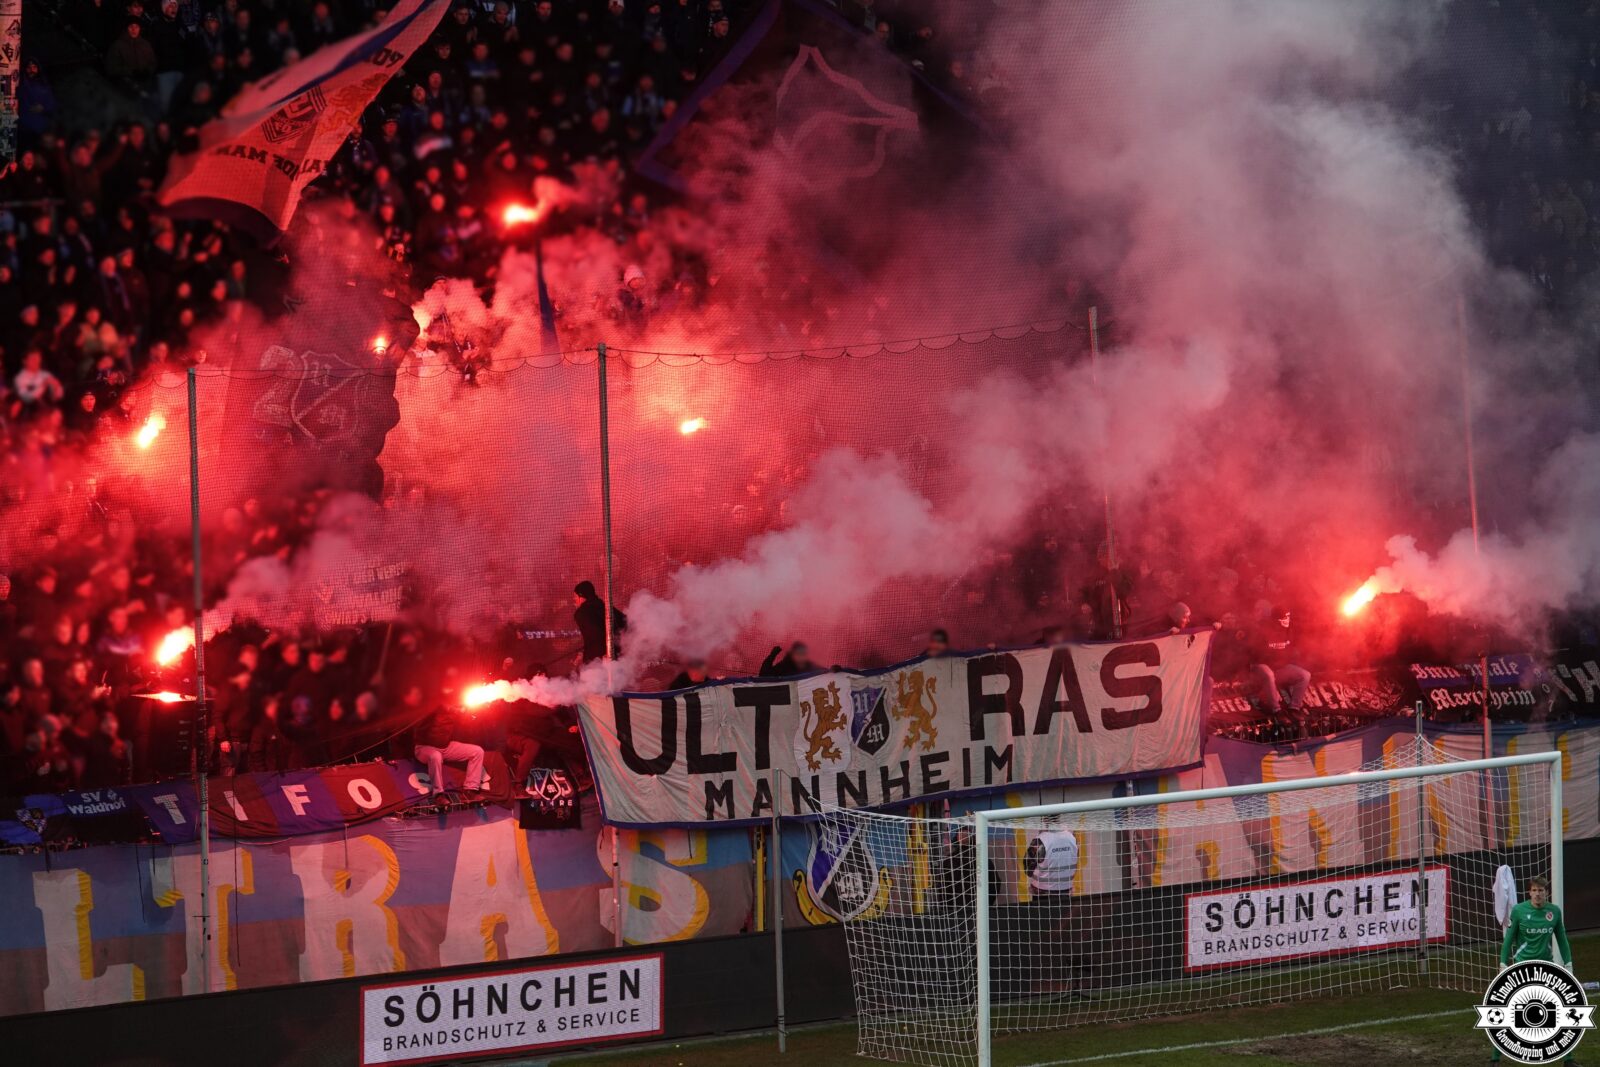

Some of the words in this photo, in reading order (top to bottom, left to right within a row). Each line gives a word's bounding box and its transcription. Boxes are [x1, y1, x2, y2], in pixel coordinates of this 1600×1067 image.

[81, 791, 101, 803] SV
[704, 744, 1012, 822] MANNHEIM
[67, 797, 126, 815] Waldhof
[1205, 878, 1430, 932] SÖHNCHEN
[1204, 928, 1329, 954] BRANDSCHUTZ
[1339, 926, 1348, 938] &
[383, 967, 640, 1028] SÖHNCHEN
[383, 1022, 526, 1051] BRANDSCHUTZ
[537, 1019, 547, 1033] &
[557, 1008, 640, 1031] SERVICE
